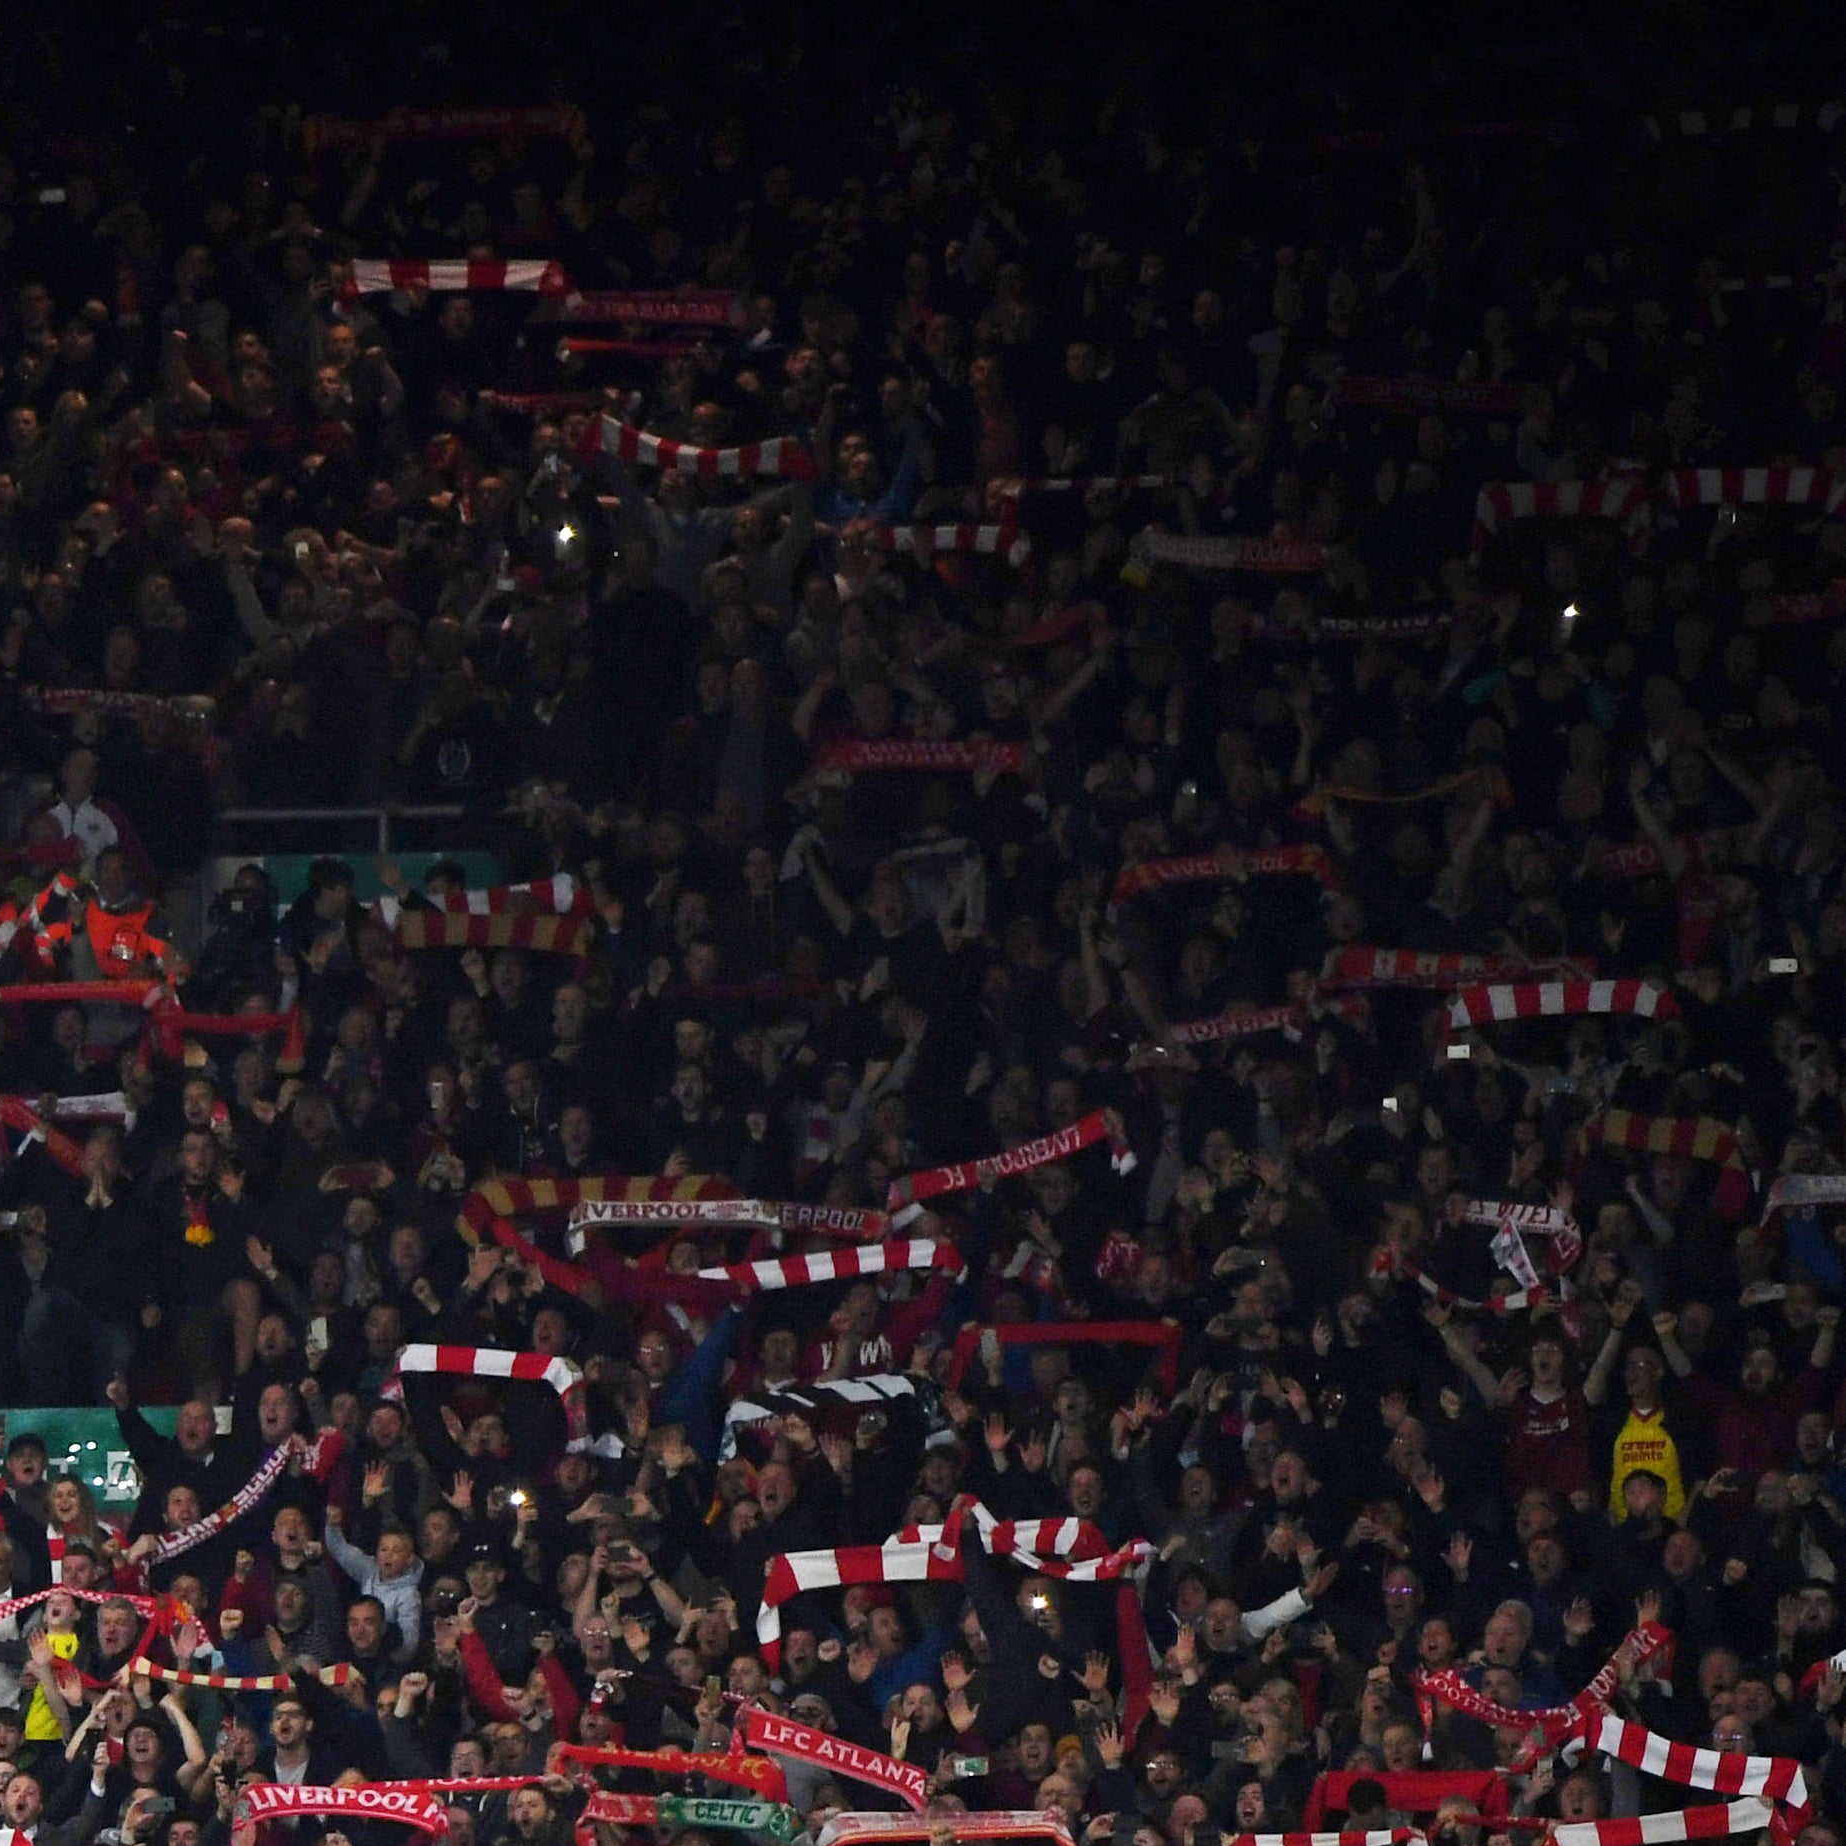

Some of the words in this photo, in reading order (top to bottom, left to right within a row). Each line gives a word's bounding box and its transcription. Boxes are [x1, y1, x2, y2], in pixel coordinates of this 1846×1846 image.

[764, 1722, 810, 1751] LFC
[816, 1739, 926, 1797] ATLANTA
[249, 1786, 419, 1812] LIVERPOOL
[694, 1801, 761, 1825] CELTIC
